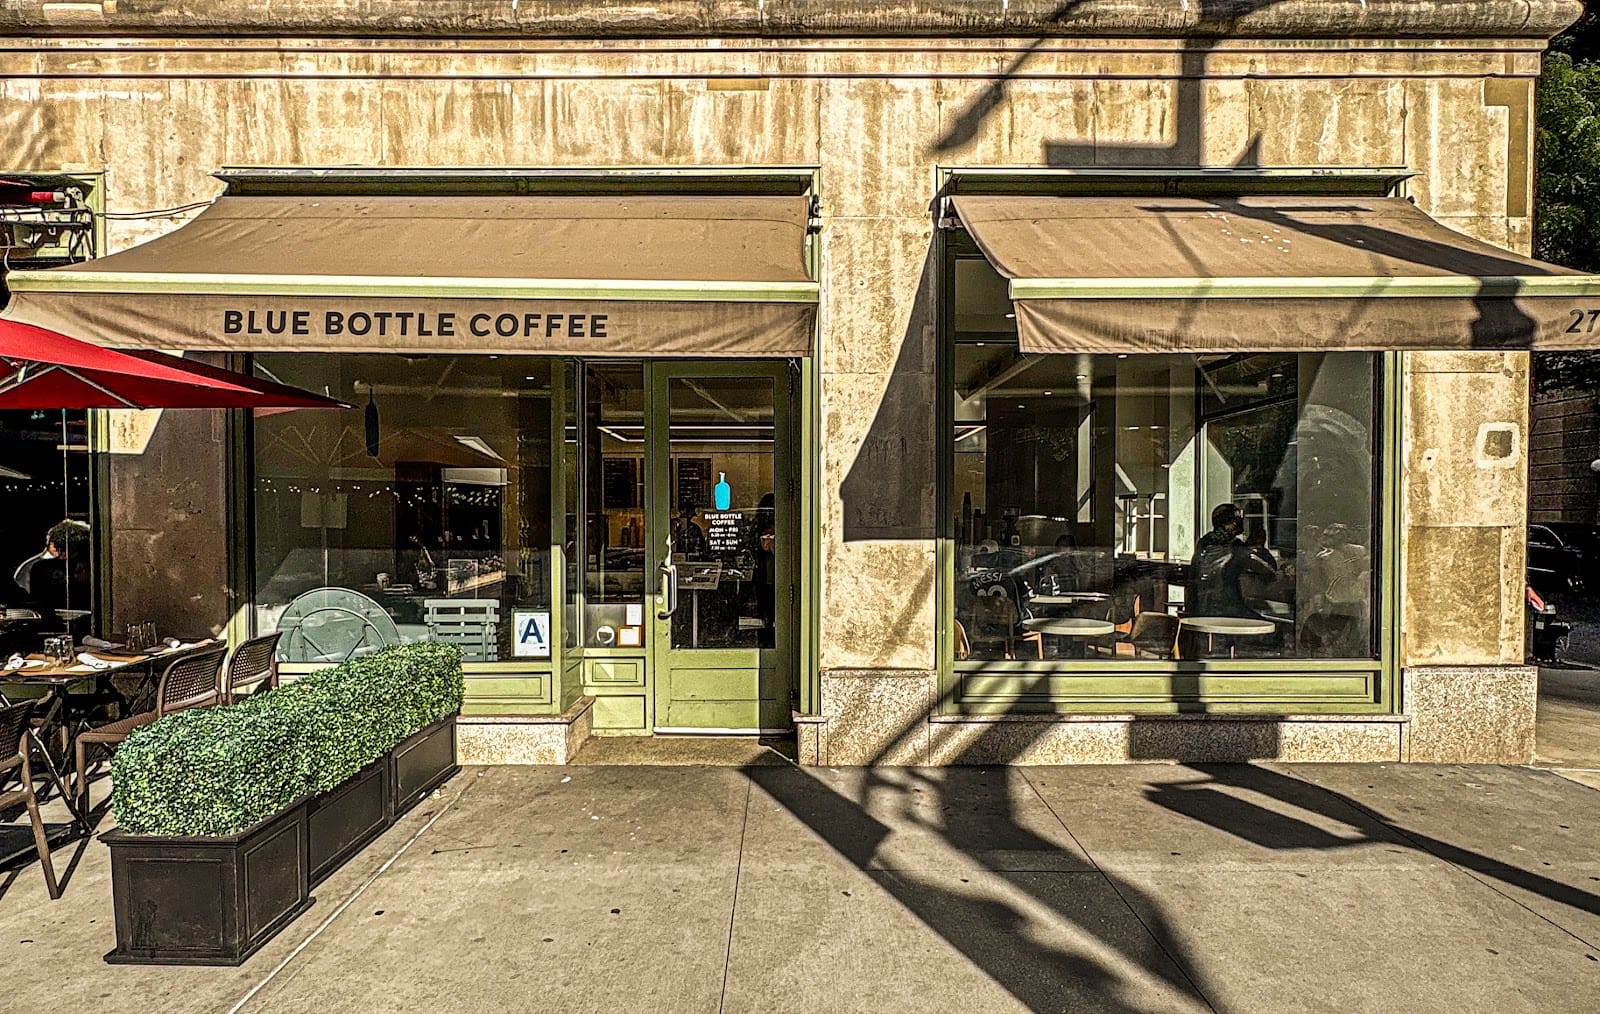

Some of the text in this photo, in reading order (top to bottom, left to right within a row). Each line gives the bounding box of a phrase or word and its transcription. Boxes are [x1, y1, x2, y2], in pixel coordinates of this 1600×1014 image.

[223, 310, 608, 338] BLUE BOTTLE COFFEE
[972, 571, 1003, 590] MESSI
[520, 618, 543, 643] A
